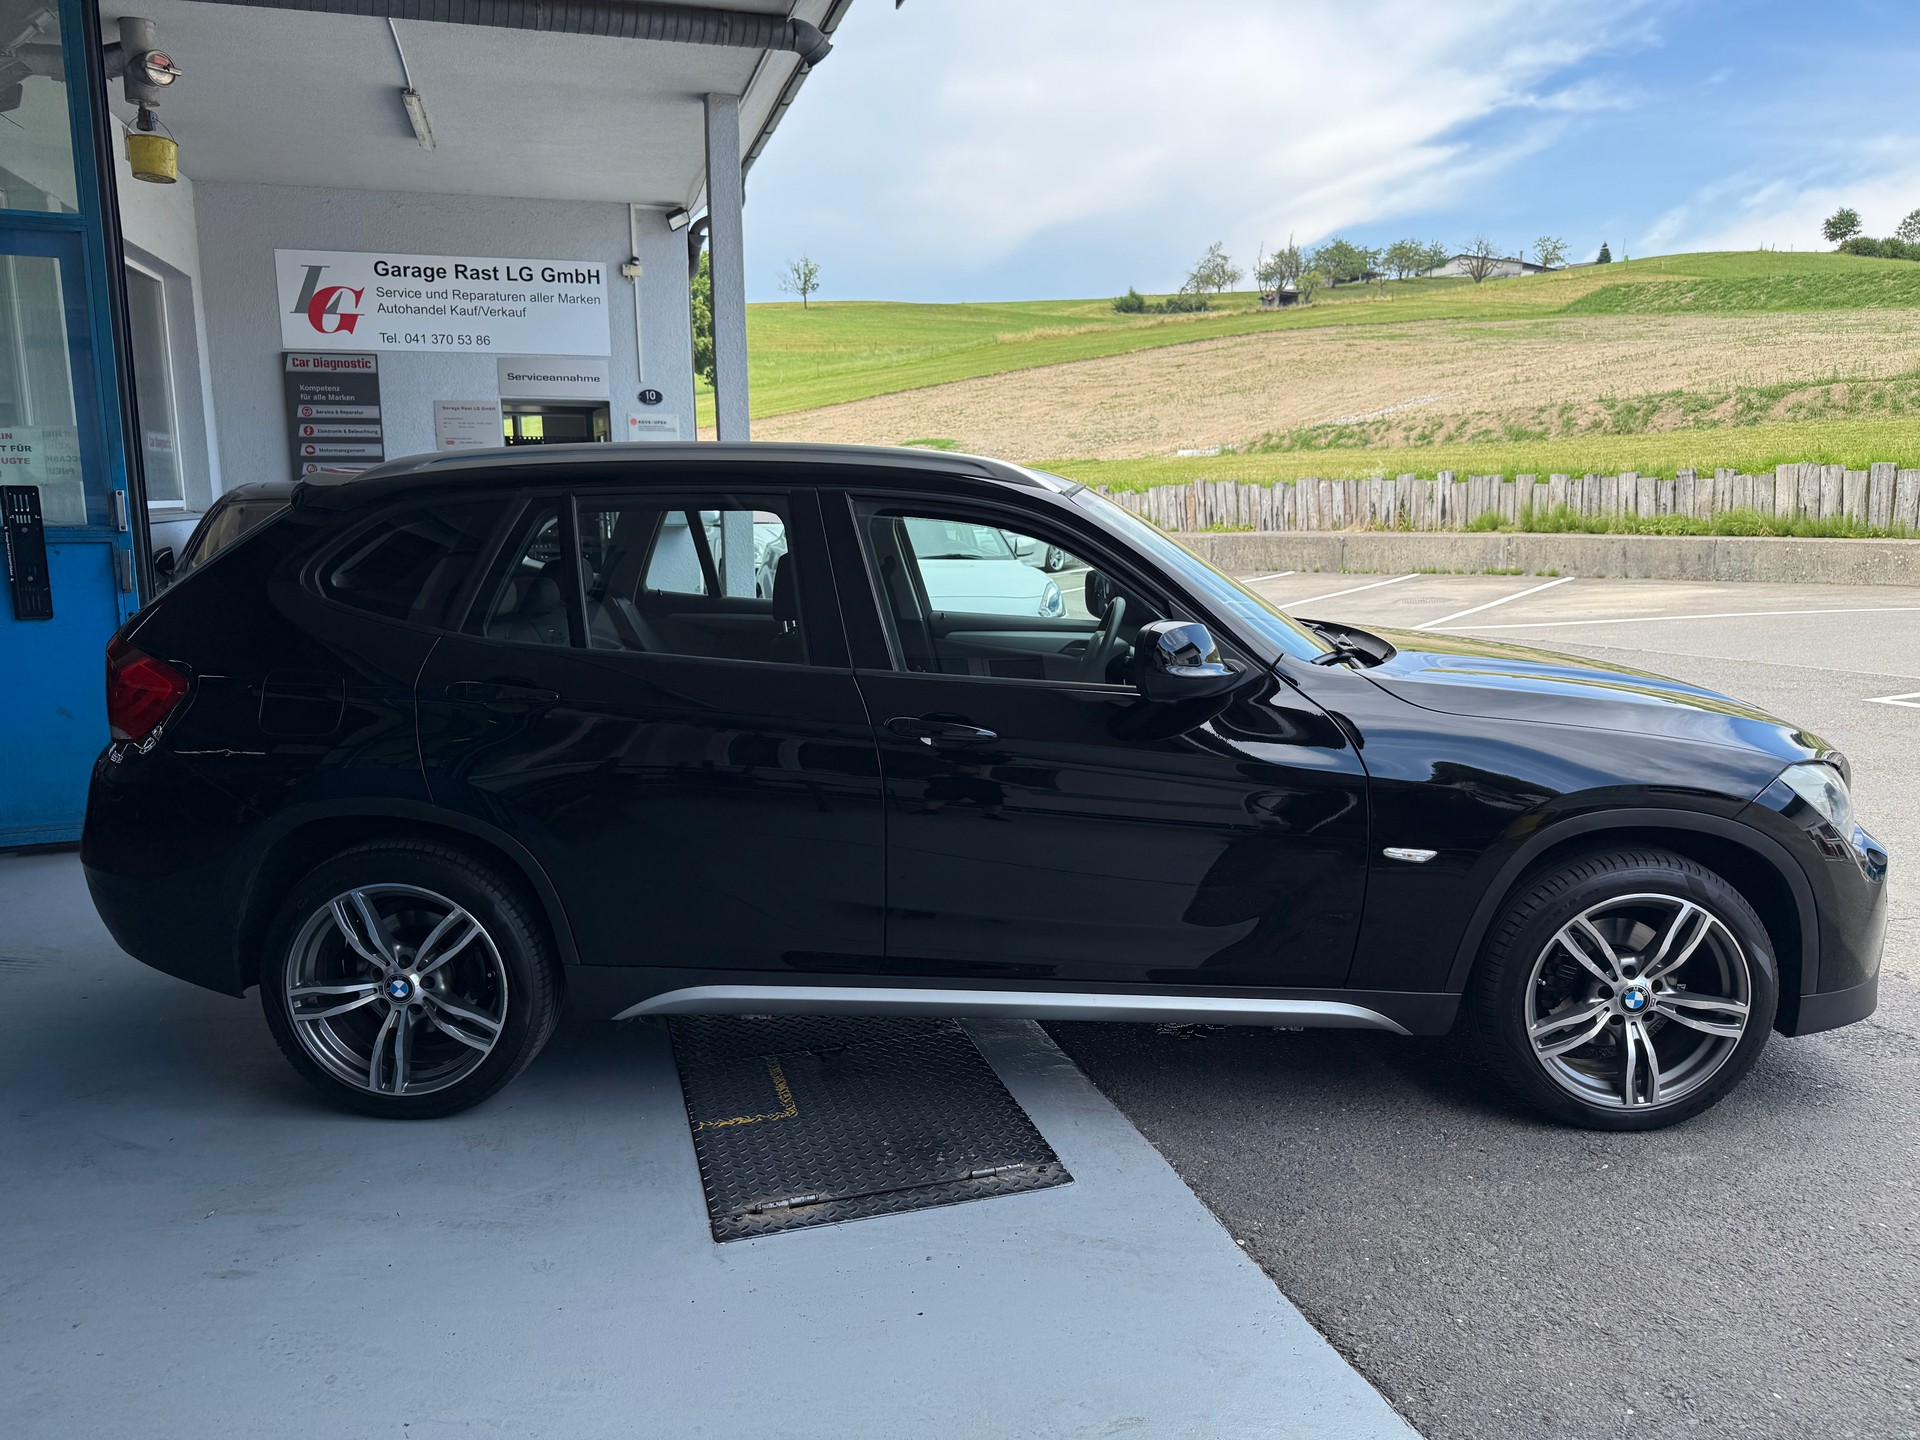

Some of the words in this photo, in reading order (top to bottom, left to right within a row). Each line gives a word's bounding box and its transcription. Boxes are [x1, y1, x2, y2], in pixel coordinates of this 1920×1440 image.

[373, 260, 447, 283] Garage
[454, 263, 500, 281] Rast
[506, 265, 533, 282] LG
[541, 266, 600, 285] GmbH
[376, 286, 422, 299] Service
[426, 289, 448, 300] und
[452, 289, 526, 303] Reparaturen
[529, 292, 555, 303] aller
[558, 293, 601, 305] Marken
[377, 302, 446, 316] Autohandel
[450, 304, 527, 318] Kauf/Verkauf
[379, 332, 401, 344] Tel.
[404, 332, 426, 344] 041
[431, 333, 454, 345] 370
[457, 334, 473, 346] 53
[476, 335, 491, 346] 86
[292, 357, 310, 368] Car
[313, 357, 372, 371] Diagnostic
[507, 372, 601, 384] Serviceannahme
[300, 384, 341, 393] Kompetenz
[645, 390, 656, 400] 10
[300, 393, 311, 401] für
[328, 394, 356, 402] Marken
[10, 443, 32, 452] FÜR
